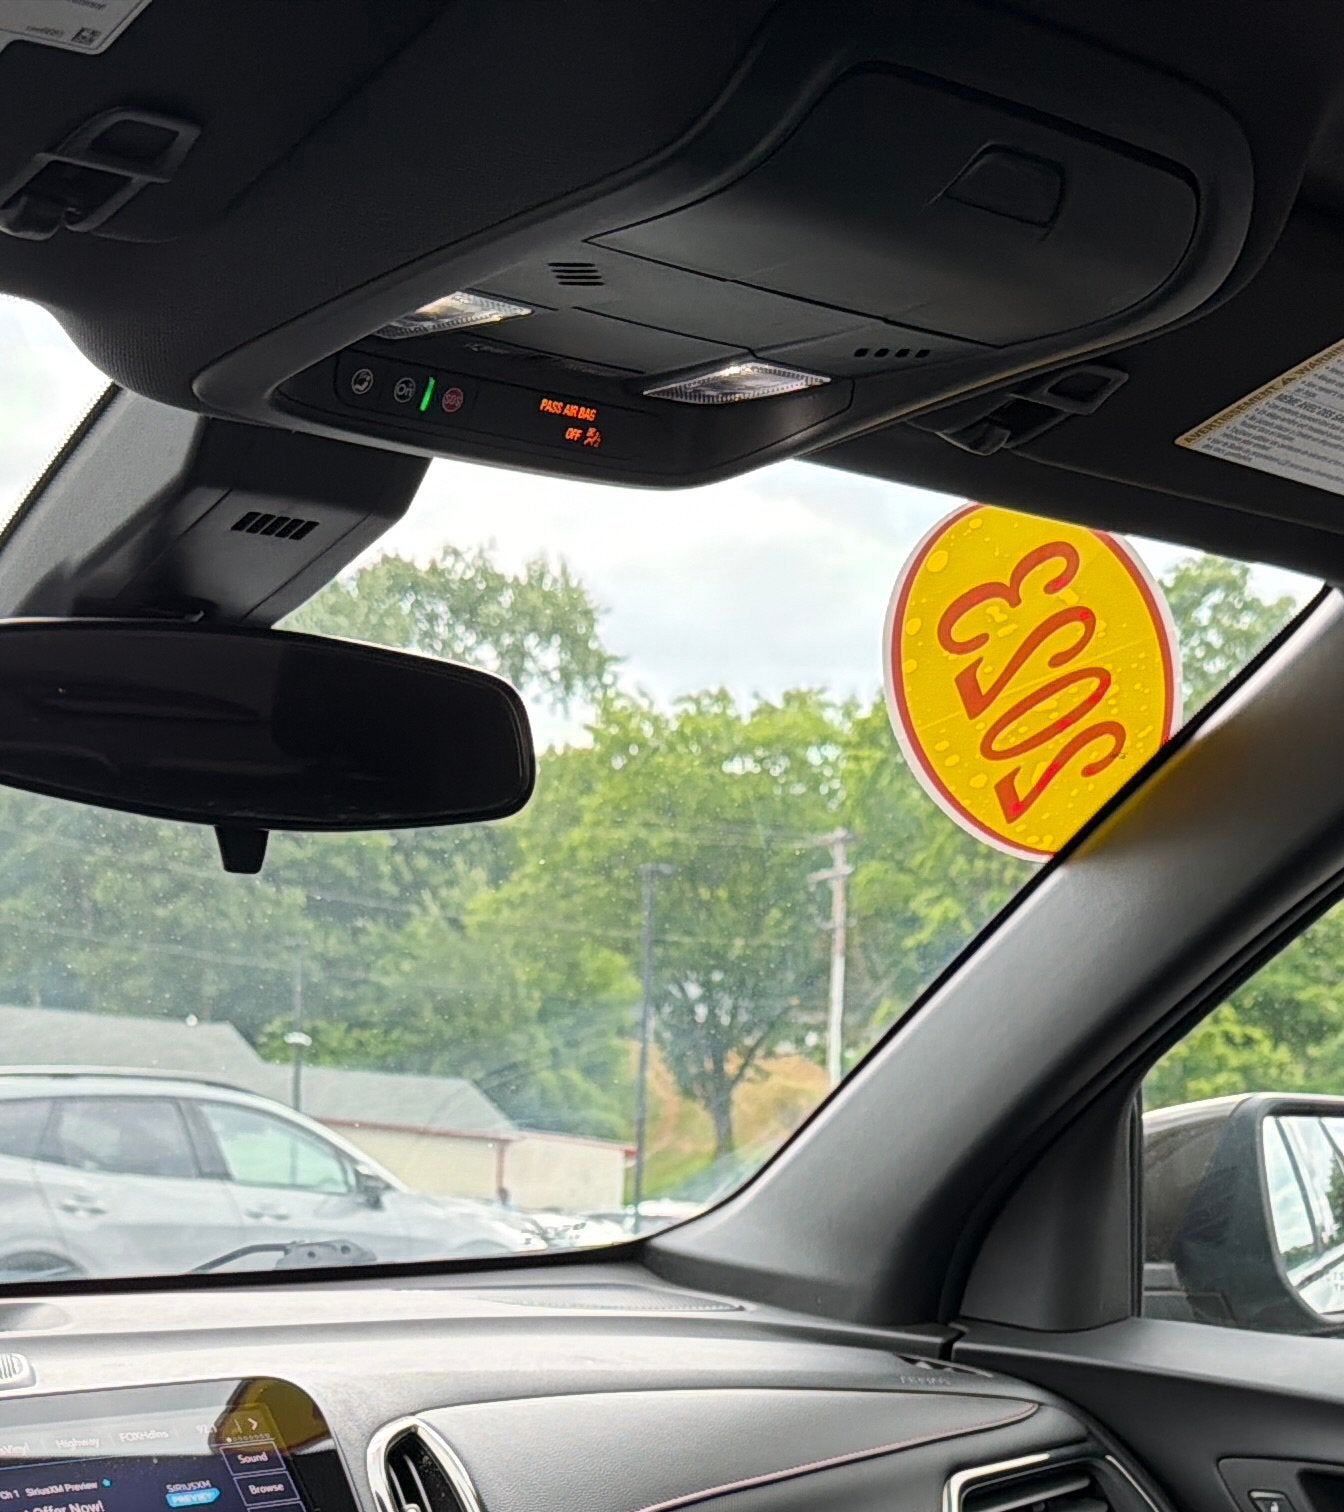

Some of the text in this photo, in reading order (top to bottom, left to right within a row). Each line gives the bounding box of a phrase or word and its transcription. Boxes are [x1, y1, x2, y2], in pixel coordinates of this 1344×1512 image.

[539, 397, 598, 422] PASS AIR BAG
[564, 426, 583, 442] OFF
[55, 1437, 101, 1450] Highway
[237, 1451, 268, 1464] Sound
[0, 1480, 98, 1501] Ch 1 SiriusXM Preview
[247, 1482, 284, 1495] Browse
